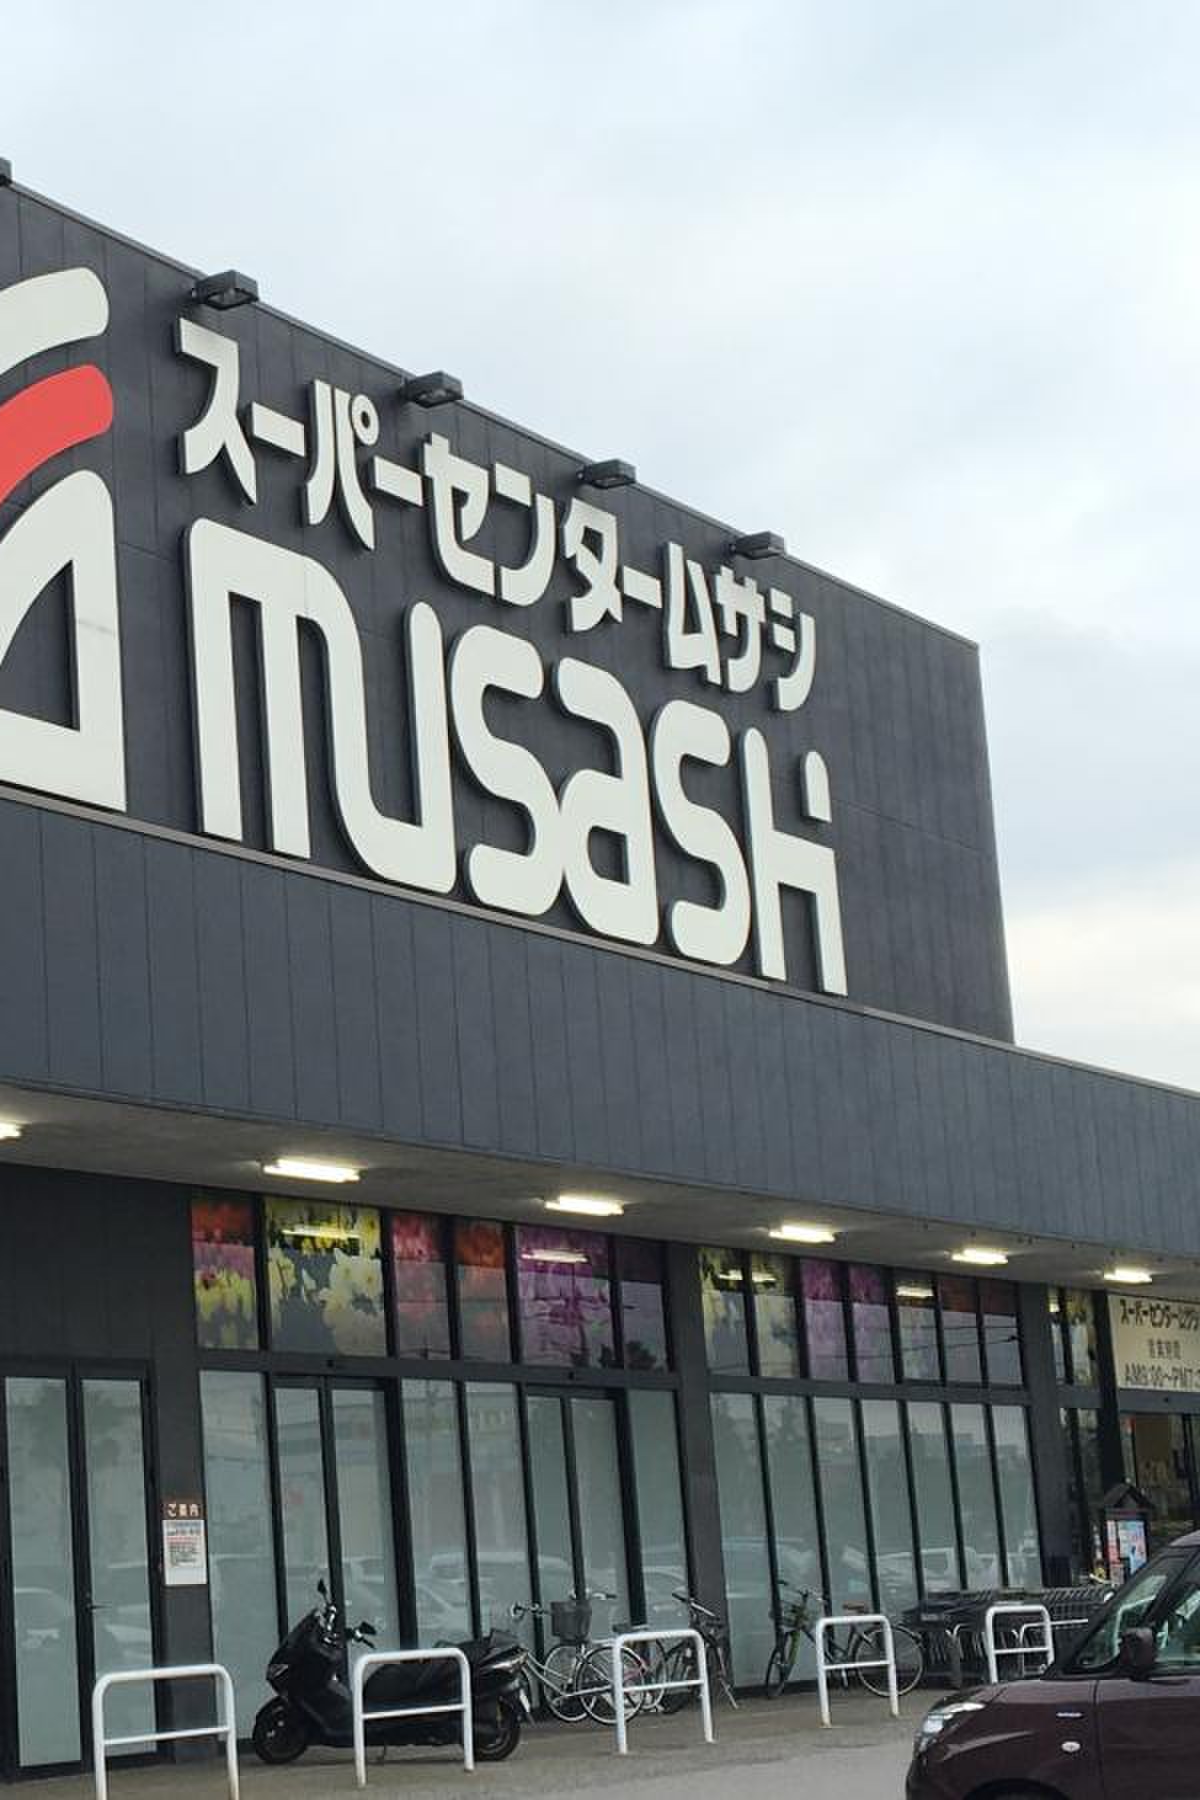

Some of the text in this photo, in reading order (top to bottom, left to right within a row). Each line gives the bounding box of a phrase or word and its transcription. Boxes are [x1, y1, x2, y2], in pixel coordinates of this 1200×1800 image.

[176, 317, 817, 713] スーパーセンタームサシ
